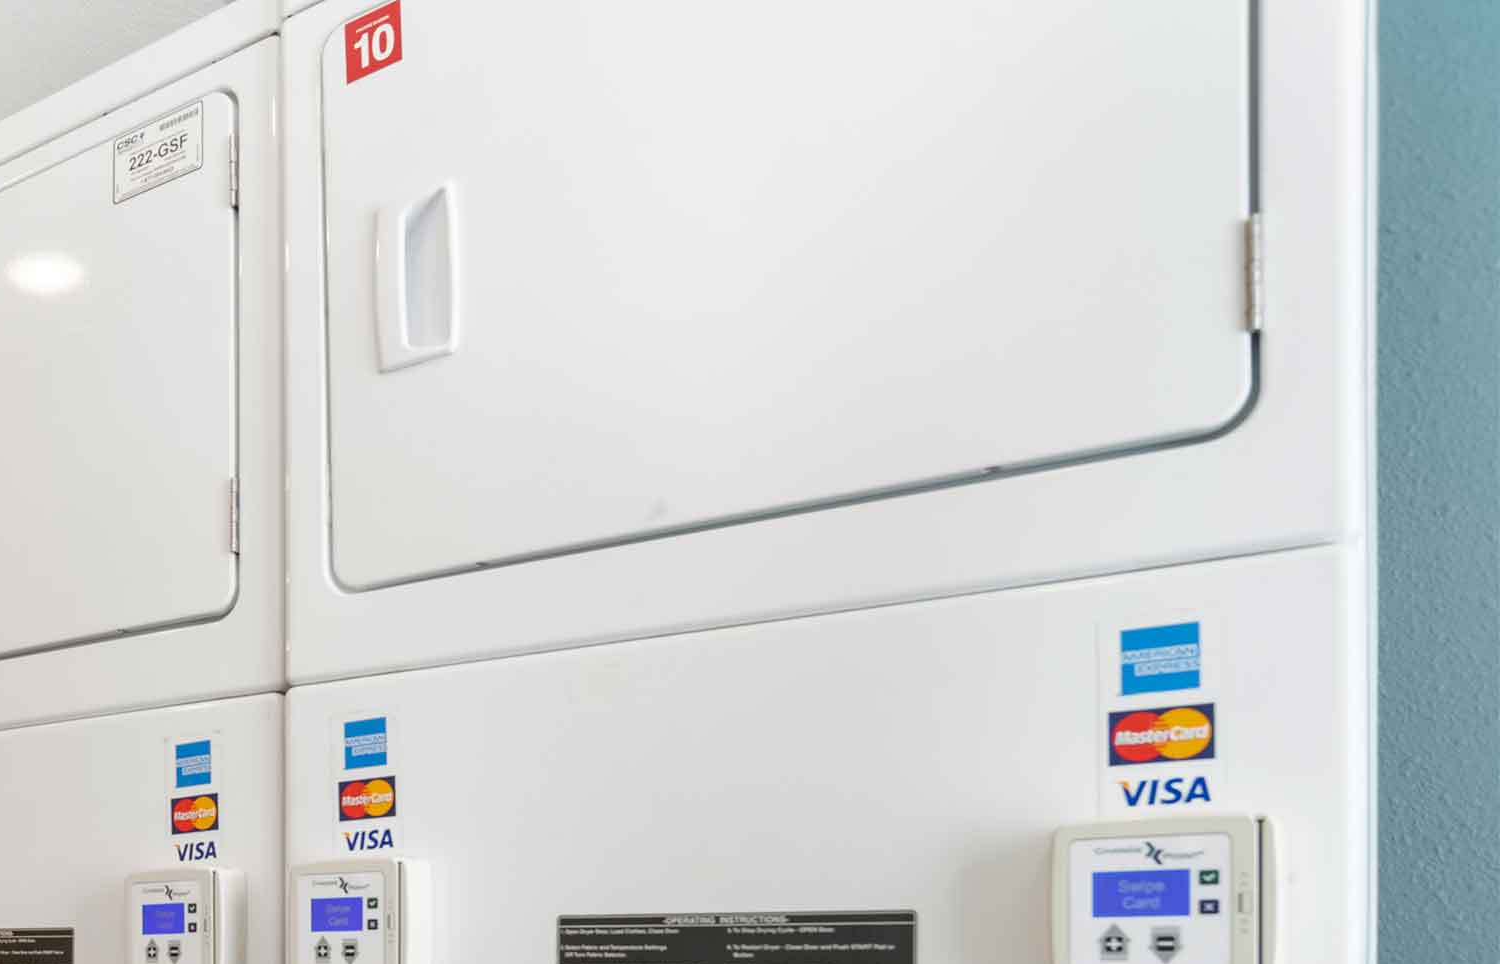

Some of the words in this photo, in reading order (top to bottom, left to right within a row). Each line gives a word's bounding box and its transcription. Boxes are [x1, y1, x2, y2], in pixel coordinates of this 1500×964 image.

[354, 23, 395, 69] 10
[128, 132, 189, 172] 222-GSF
[1113, 722, 1210, 746] MasterCard
[1116, 776, 1212, 807] VISA
[175, 841, 217, 861] VISA
[343, 828, 394, 851] VISA
[1117, 880, 1166, 894] Swipe
[1122, 896, 1161, 910] Card
